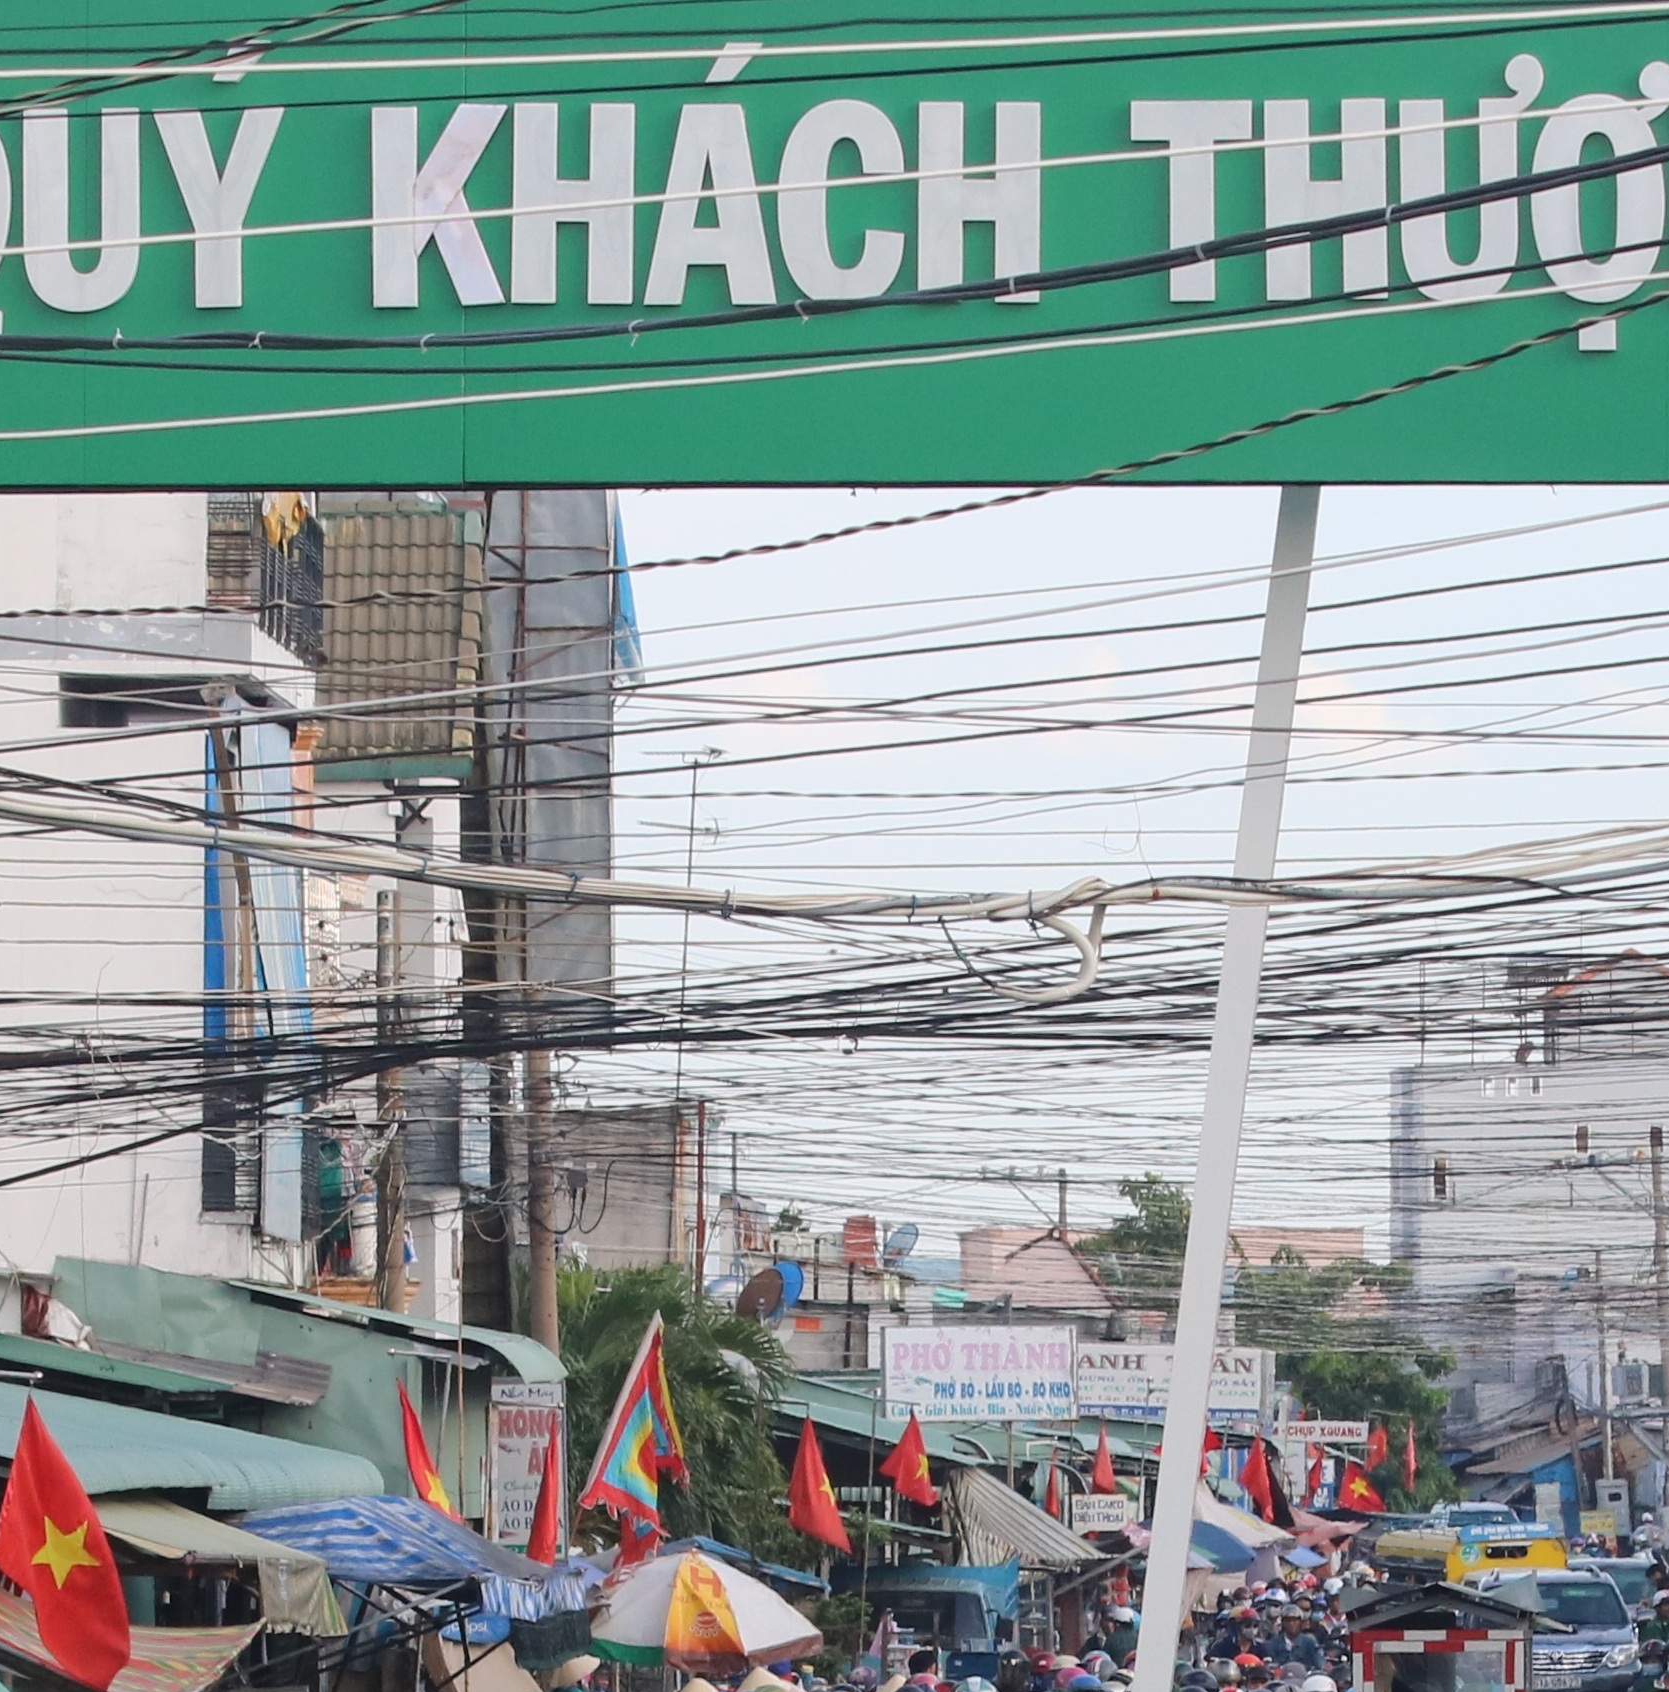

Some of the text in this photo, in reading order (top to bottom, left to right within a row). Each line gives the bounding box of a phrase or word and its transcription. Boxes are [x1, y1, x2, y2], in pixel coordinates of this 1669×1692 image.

[374, 42, 1043, 309] KHÁCH
[892, 1330, 1069, 1371] PHỞ THÀNH
[1049, 1381, 1071, 1398] KHO
